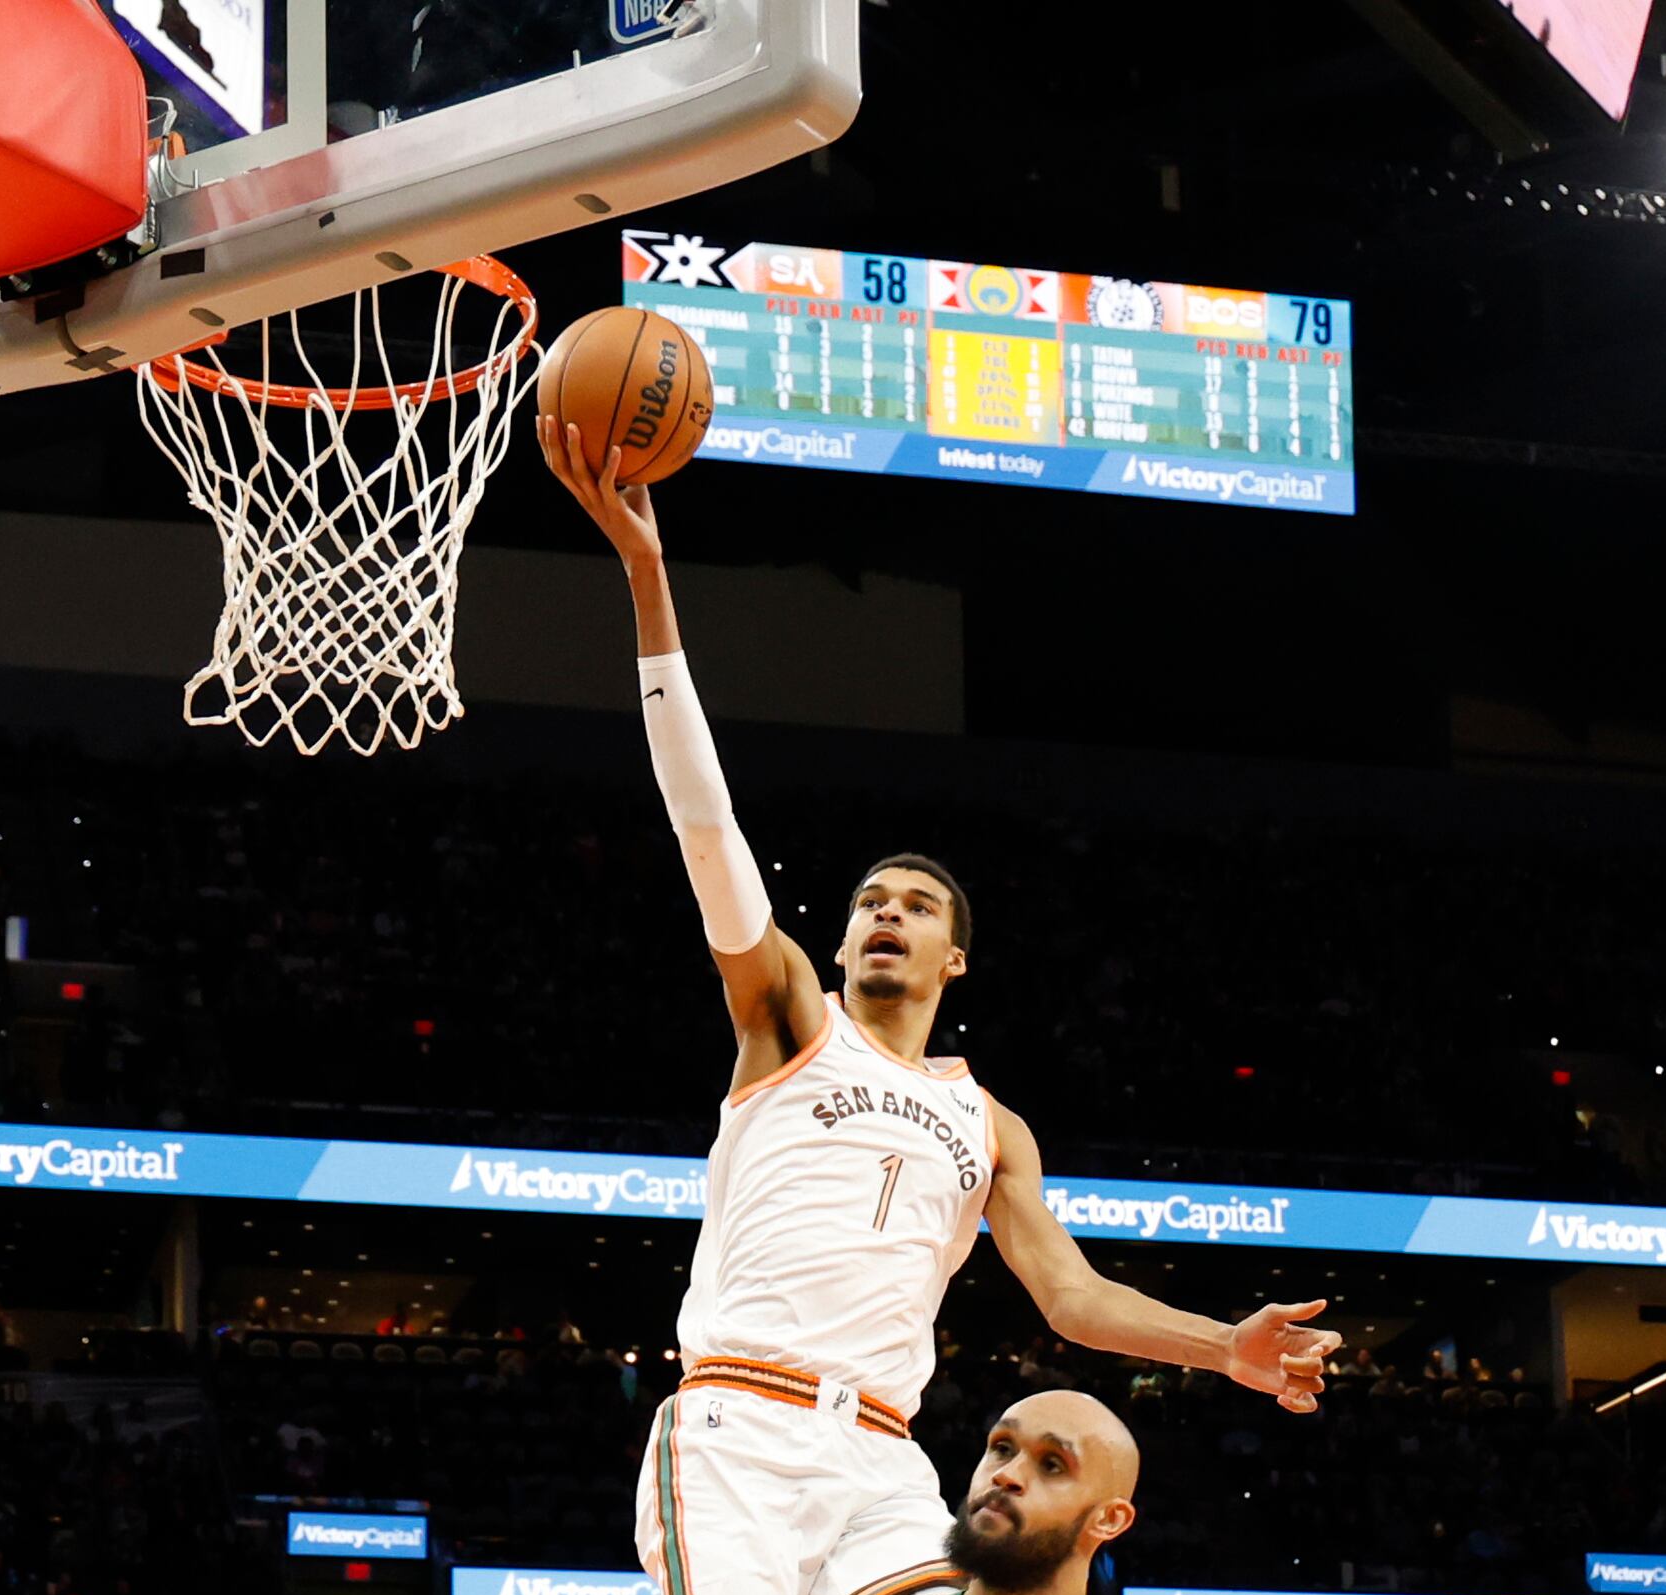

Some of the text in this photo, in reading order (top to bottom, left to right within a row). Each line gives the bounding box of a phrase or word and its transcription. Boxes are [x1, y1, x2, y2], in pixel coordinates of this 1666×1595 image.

[863, 257, 907, 304] 58
[1187, 295, 1332, 347] BOS 79
[624, 340, 678, 449] Wilson
[704, 425, 856, 464] toryCapital
[998, 451, 1045, 478] today
[1139, 459, 1327, 502] VictoryCapital
[812, 1086, 977, 1191] SAN ANTONIO
[473, 1161, 707, 1213] VictoryCapit
[873, 1154, 904, 1232] 1
